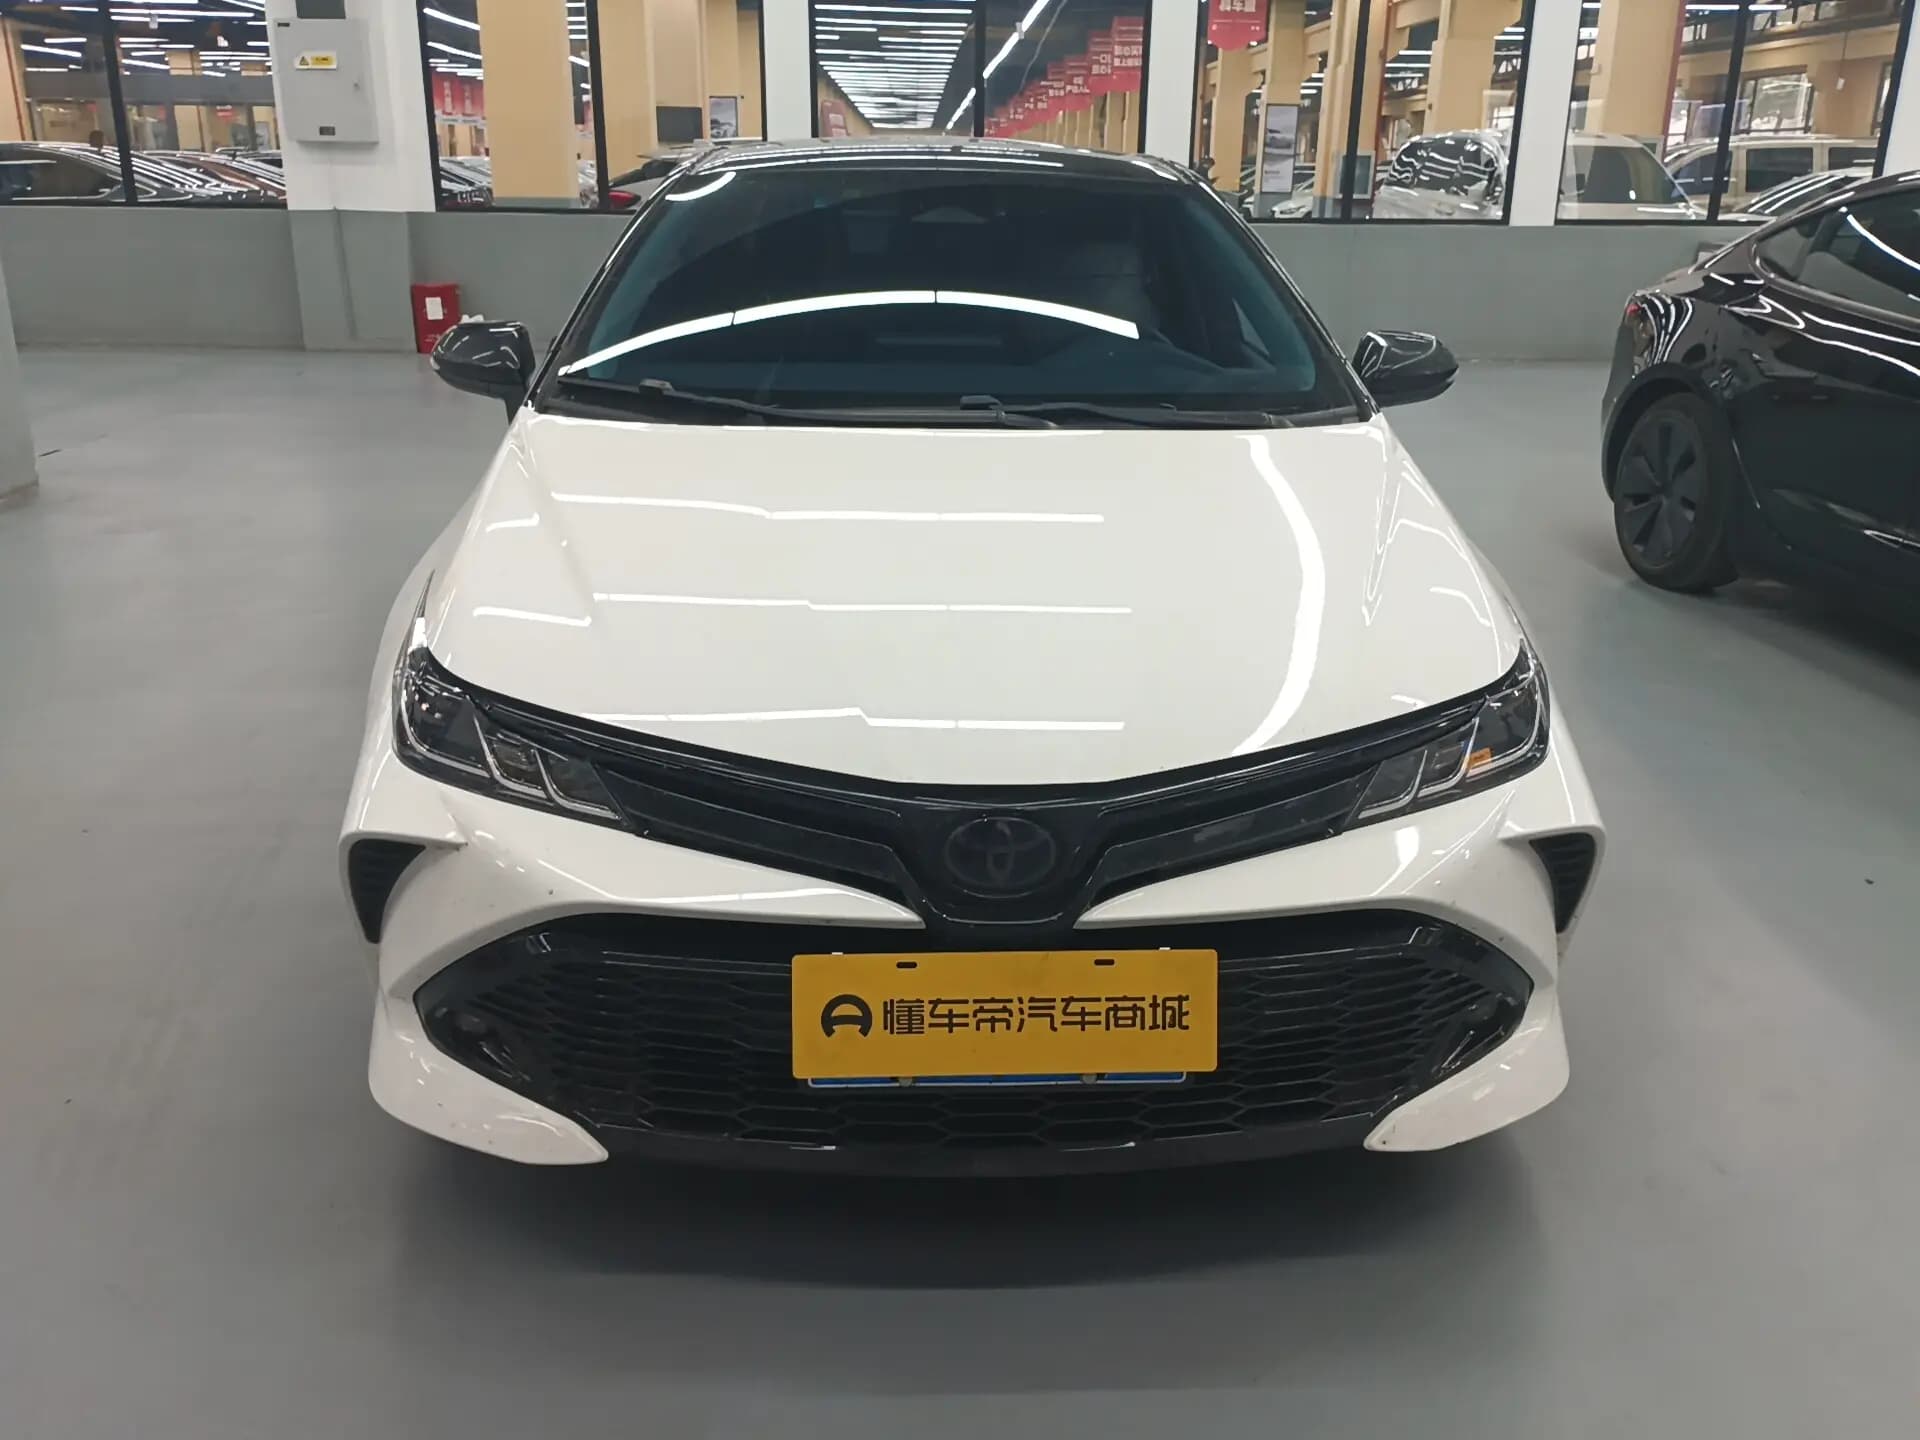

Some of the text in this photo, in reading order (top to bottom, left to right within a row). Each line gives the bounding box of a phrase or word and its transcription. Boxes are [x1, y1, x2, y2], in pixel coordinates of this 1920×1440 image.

[882, 994, 1190, 1035] 懂车帝汽车商城
